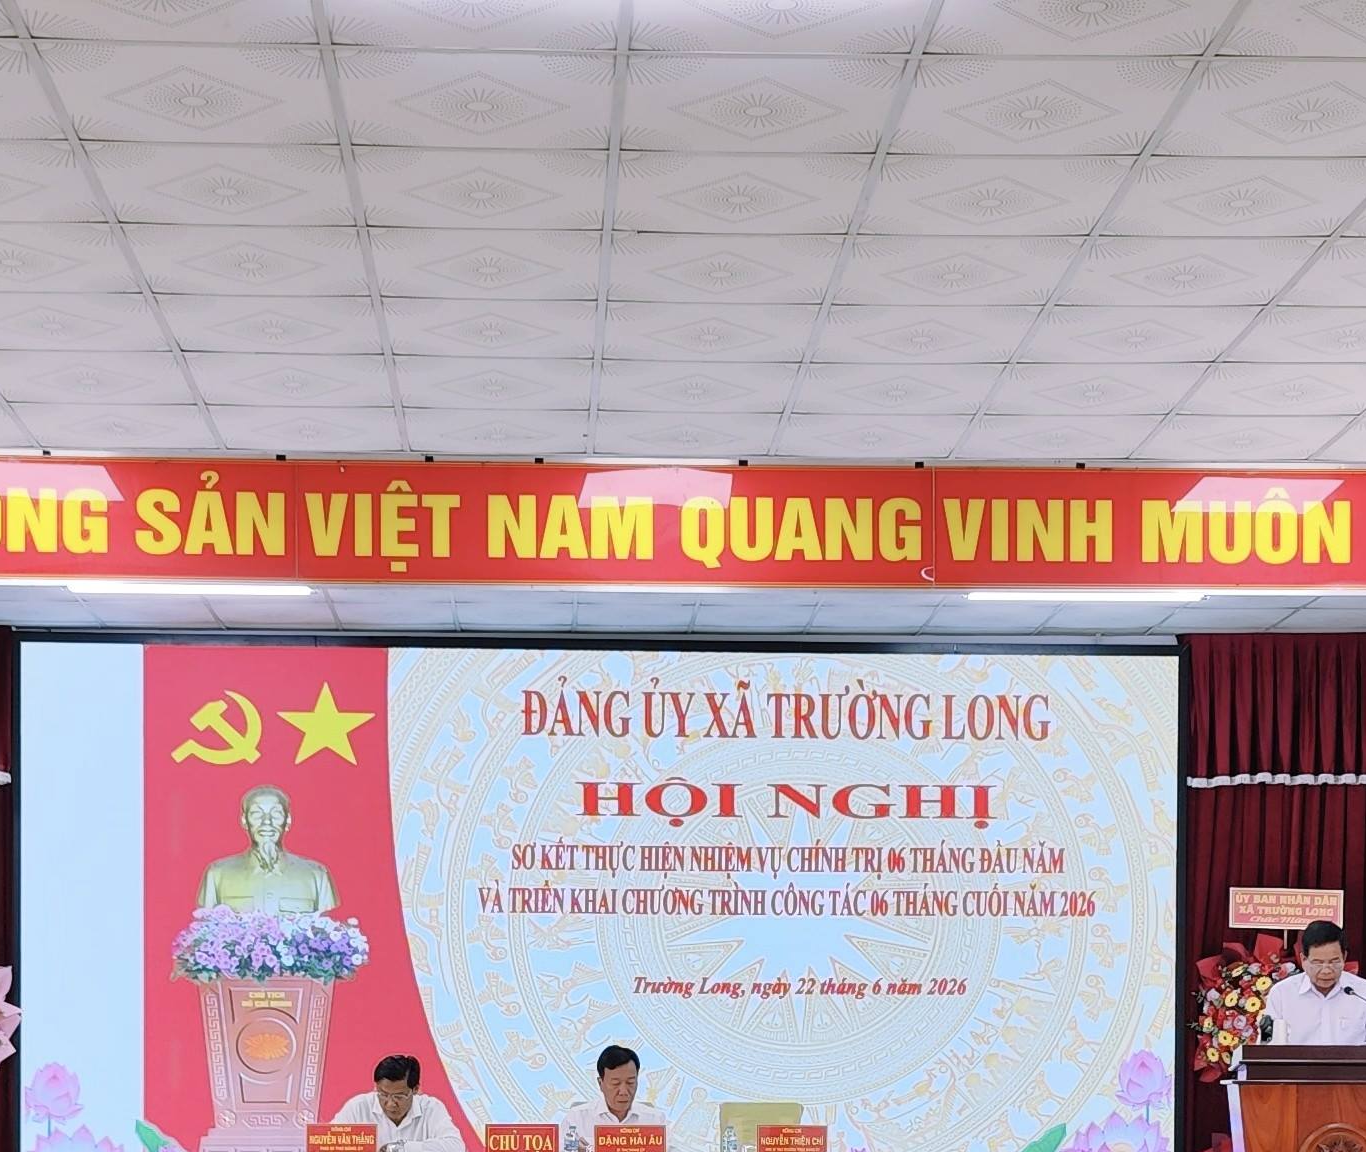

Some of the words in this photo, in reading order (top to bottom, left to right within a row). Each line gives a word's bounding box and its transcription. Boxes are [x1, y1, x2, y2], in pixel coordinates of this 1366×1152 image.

[135, 470, 287, 557] SẢN
[305, 481, 462, 573] VIỆT
[488, 493, 654, 562] NAM
[679, 496, 923, 570] QUANG
[943, 498, 1111, 565] VINH
[1142, 487, 1353, 565] MUÔN
[521, 675, 632, 737] ĐẢNG
[644, 677, 694, 738] ỦY
[704, 681, 755, 739] XÃ
[767, 679, 932, 741] TRƯỜNG
[944, 695, 1051, 741] LONG
[576, 777, 742, 827] HỘI
[766, 784, 997, 828] NGHỊ
[511, 845, 538, 871] SƠ
[541, 837, 578, 871] KẾT
[582, 845, 636, 875] THỰC
[639, 843, 687, 877] HIỆN
[689, 844, 753, 877] NHIỆM
[755, 847, 785, 877] VỤ
[787, 839, 847, 873] CHÍNH
[851, 847, 883, 877] TRỊ
[887, 848, 905, 873] 06
[909, 840, 976, 874] THÁNG
[979, 838, 1018, 874] ĐẦU
[1021, 842, 1065, 874] NĂM
[479, 880, 504, 914] VÀ
[508, 880, 567, 914] TRIỂN
[570, 889, 618, 915] KHAI
[621, 885, 704, 916] CHƯƠNG
[708, 881, 766, 916] TRÌNH
[770, 883, 825, 917] CÔNG
[829, 881, 868, 917] TÁC
[870, 891, 889, 917] 06
[892, 882, 958, 917] THÁNG
[962, 880, 1009, 918] CUỐI
[1012, 882, 1057, 918] NĂM
[1060, 891, 1096, 918] 2026
[633, 975, 693, 998] Trường
[699, 977, 746, 998] Long,
[751, 979, 791, 999] ngày
[795, 978, 815, 996] 22
[819, 976, 867, 999] tháng
[871, 978, 882, 996] 6
[886, 977, 923, 996] năm
[926, 977, 967, 996] 2026
[489, 1130, 520, 1151] CHỦ
